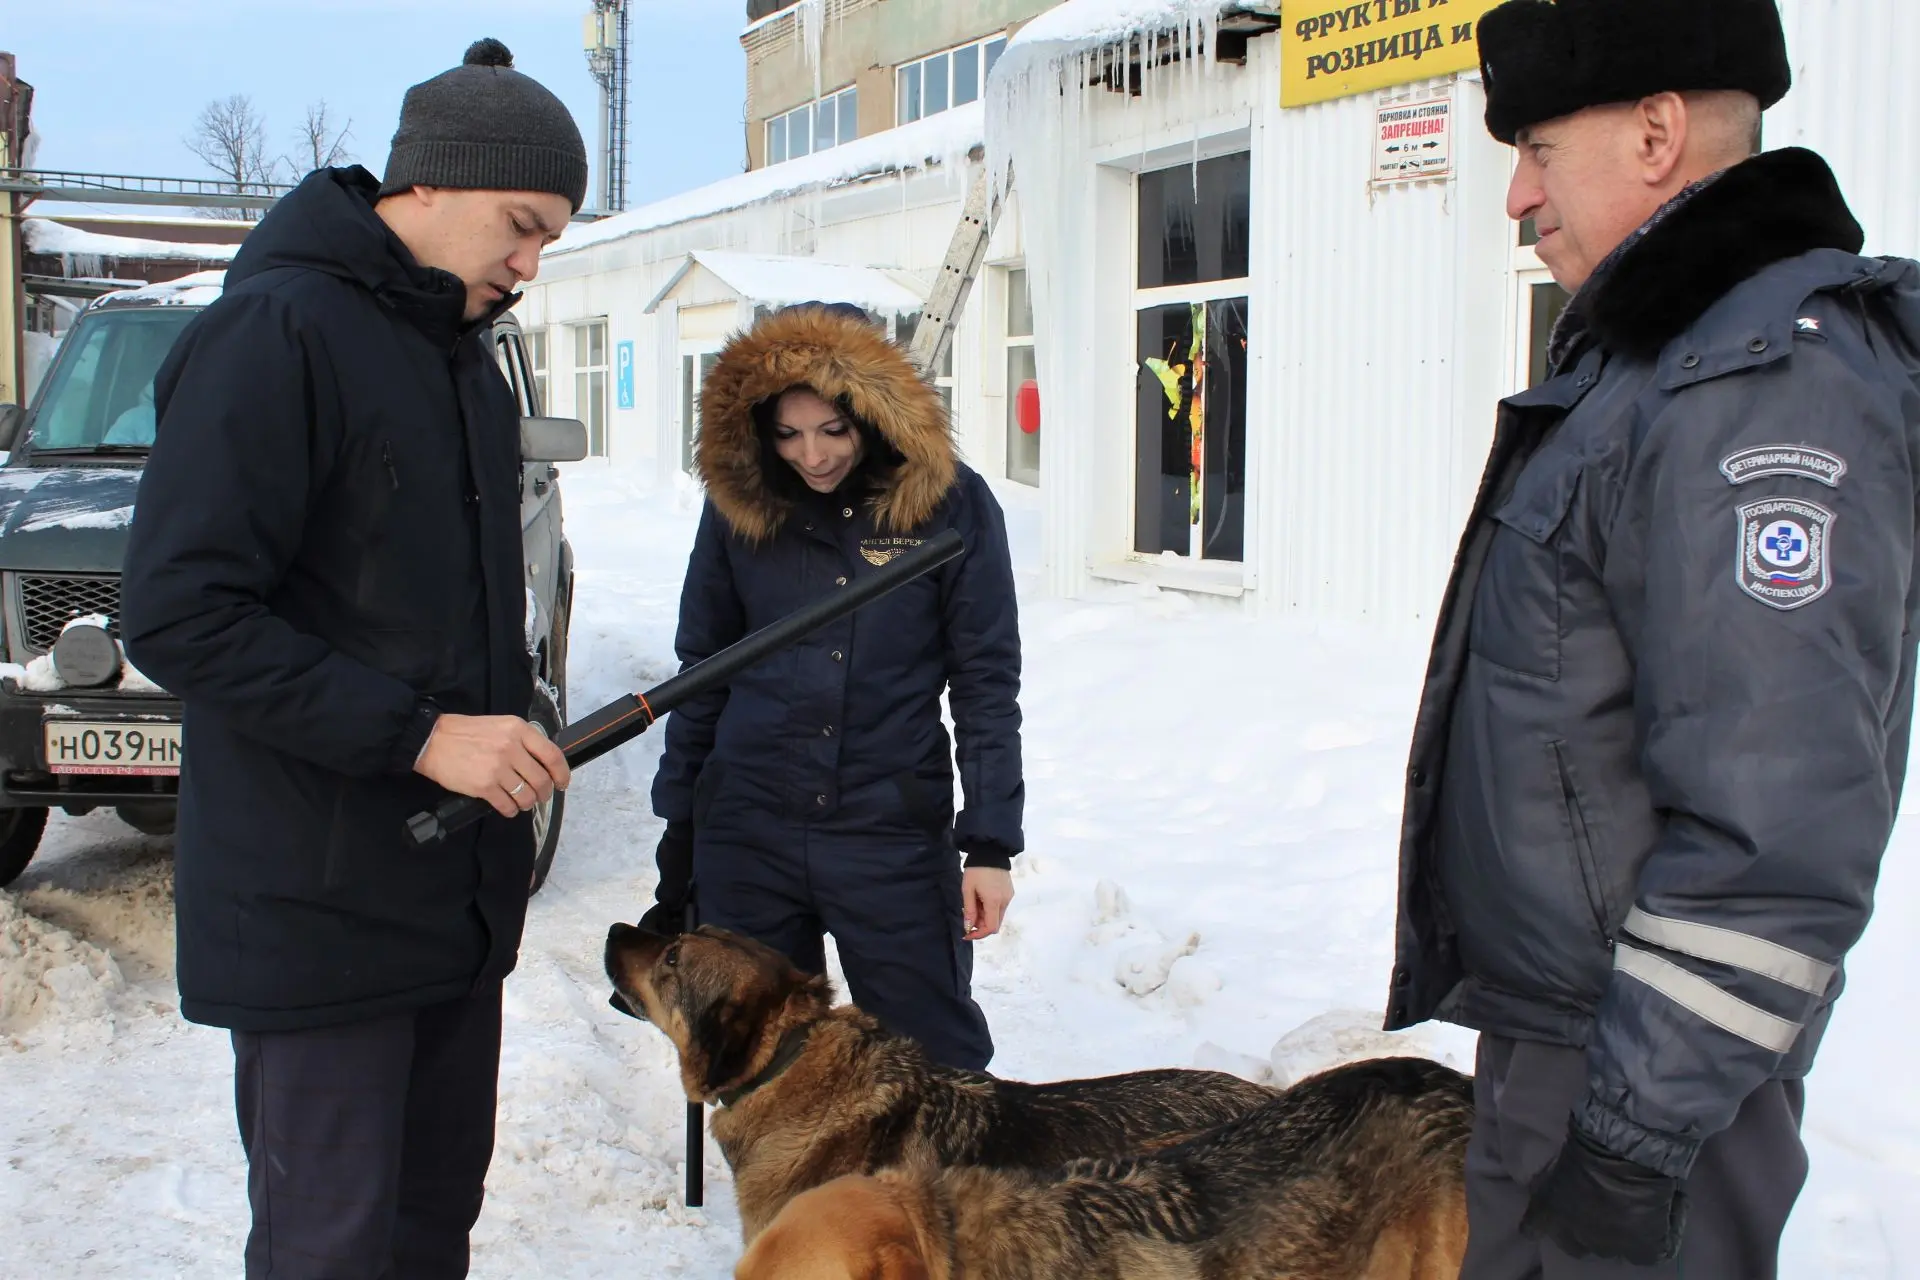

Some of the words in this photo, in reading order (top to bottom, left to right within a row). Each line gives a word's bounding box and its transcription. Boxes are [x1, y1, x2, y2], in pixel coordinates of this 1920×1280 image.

[1296, 0, 1420, 42] ФРУКТЫ
[1306, 24, 1444, 80] РОЗНИЦА
[1379, 111, 1411, 123] ПАРКОВКА
[1412, 110, 1418, 118] И
[1419, 104, 1448, 118] СТОЯНКА
[1381, 118, 1444, 141] ЗАПРЕЩЕНА!
[1403, 144, 1409, 152] 6
[620, 346, 630, 380] P
[1729, 453, 1801, 474] ВЕТЕРИНАРНЫЙ
[1801, 455, 1838, 474] НАДЗОР
[1744, 502, 1828, 524] ГОСУДАРСТВЕННАЯ
[892, 537, 923, 547] БЕРЕЖ
[1750, 581, 1818, 598] ИНСПЕКЦИЯ
[56, 766, 114, 774] АВТОСЕТЬ
[116, 767, 136, 775] РФ
